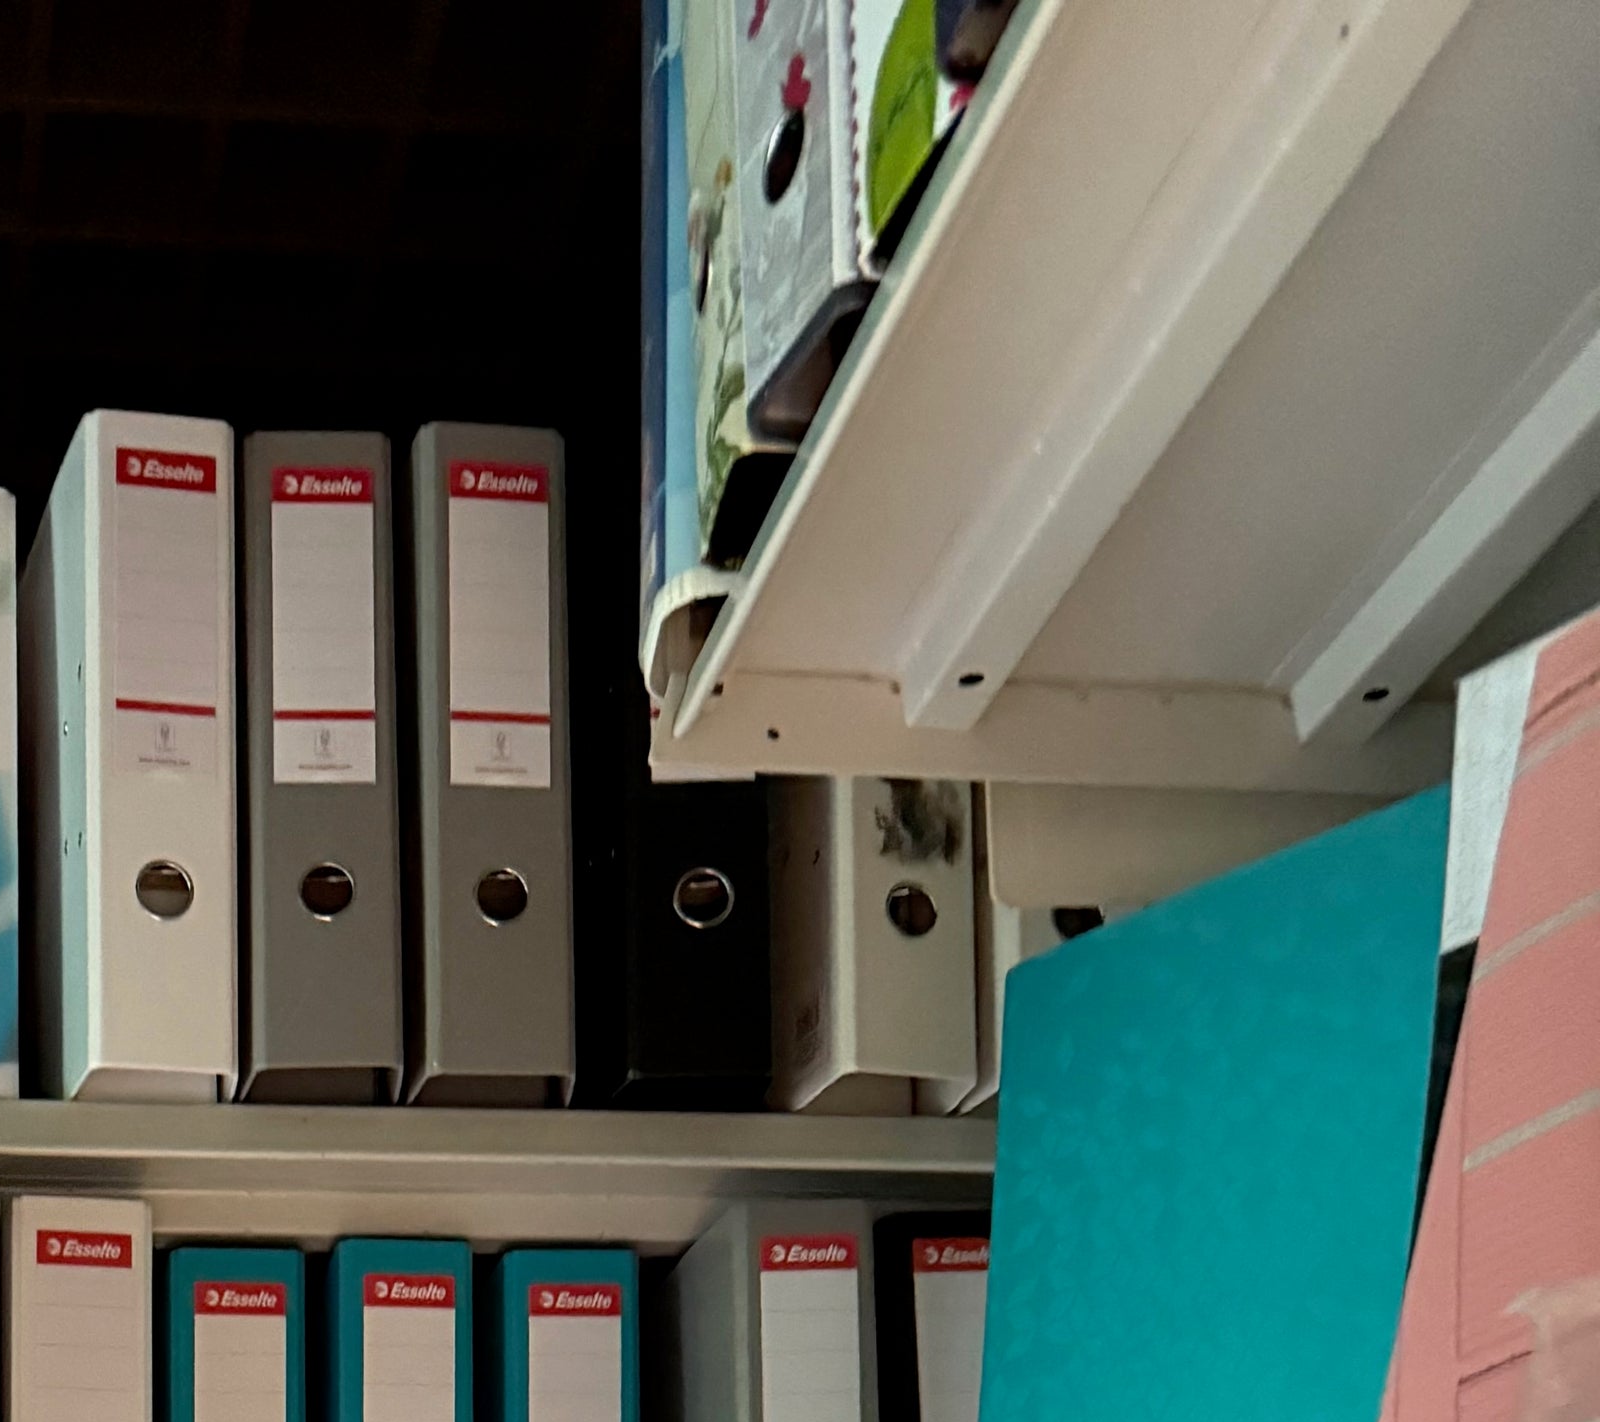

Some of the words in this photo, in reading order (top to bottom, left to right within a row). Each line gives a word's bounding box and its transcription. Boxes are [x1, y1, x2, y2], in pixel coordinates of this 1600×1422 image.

[143, 458, 204, 485] Esselte
[299, 475, 363, 497] Esselte
[63, 1240, 121, 1260] Esselte
[786, 1244, 848, 1263] Esselte
[220, 1290, 278, 1308] Esselte
[390, 1282, 447, 1301] Esselte
[555, 1291, 613, 1309] Esselte
